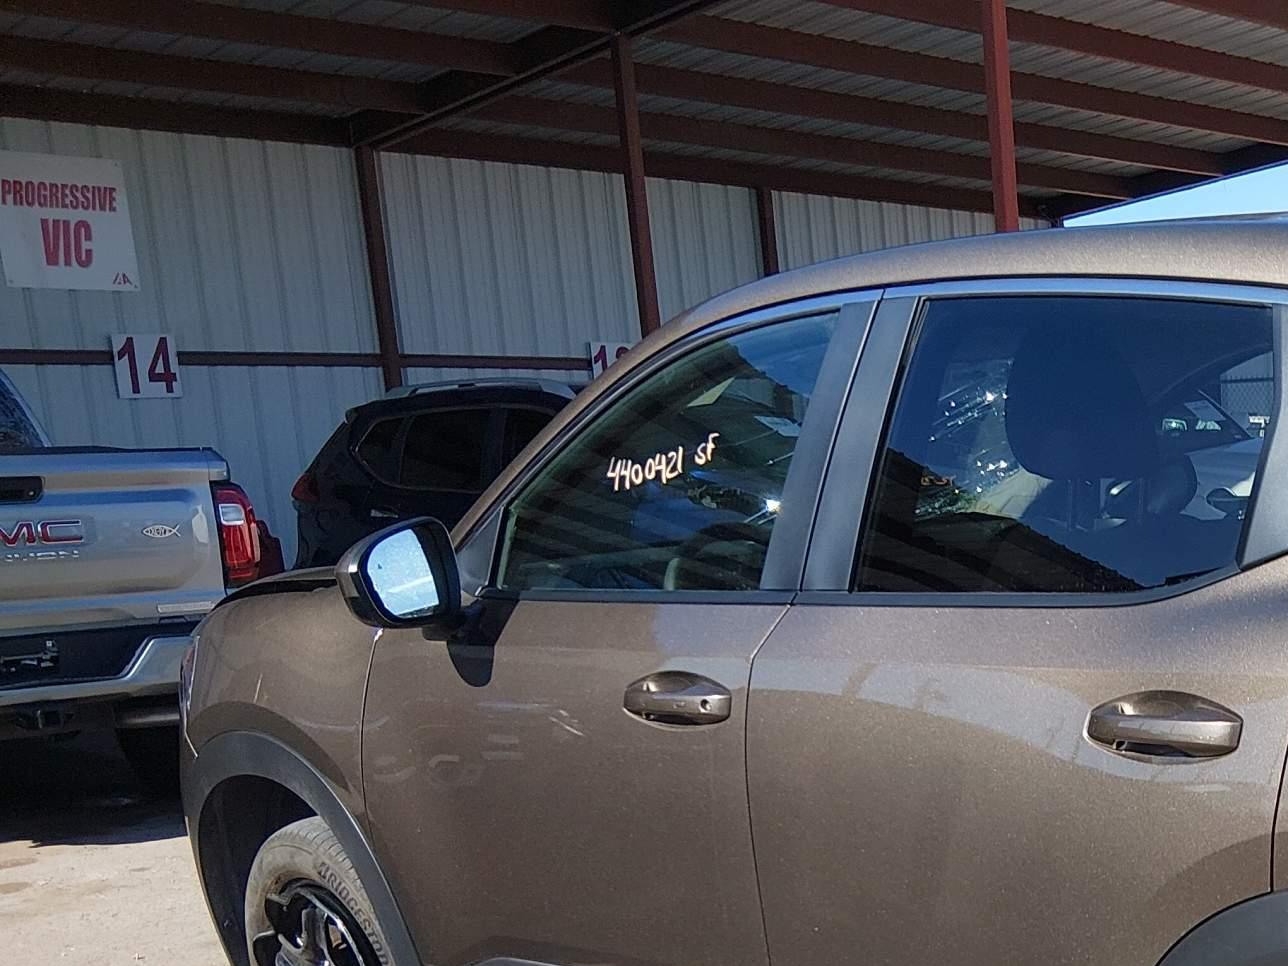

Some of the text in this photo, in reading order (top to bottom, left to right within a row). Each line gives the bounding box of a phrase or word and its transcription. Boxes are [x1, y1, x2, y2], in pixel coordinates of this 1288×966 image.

[1, 178, 117, 213] PROGRESSIVE
[40, 218, 94, 269] VIC
[117, 336, 178, 395] 14
